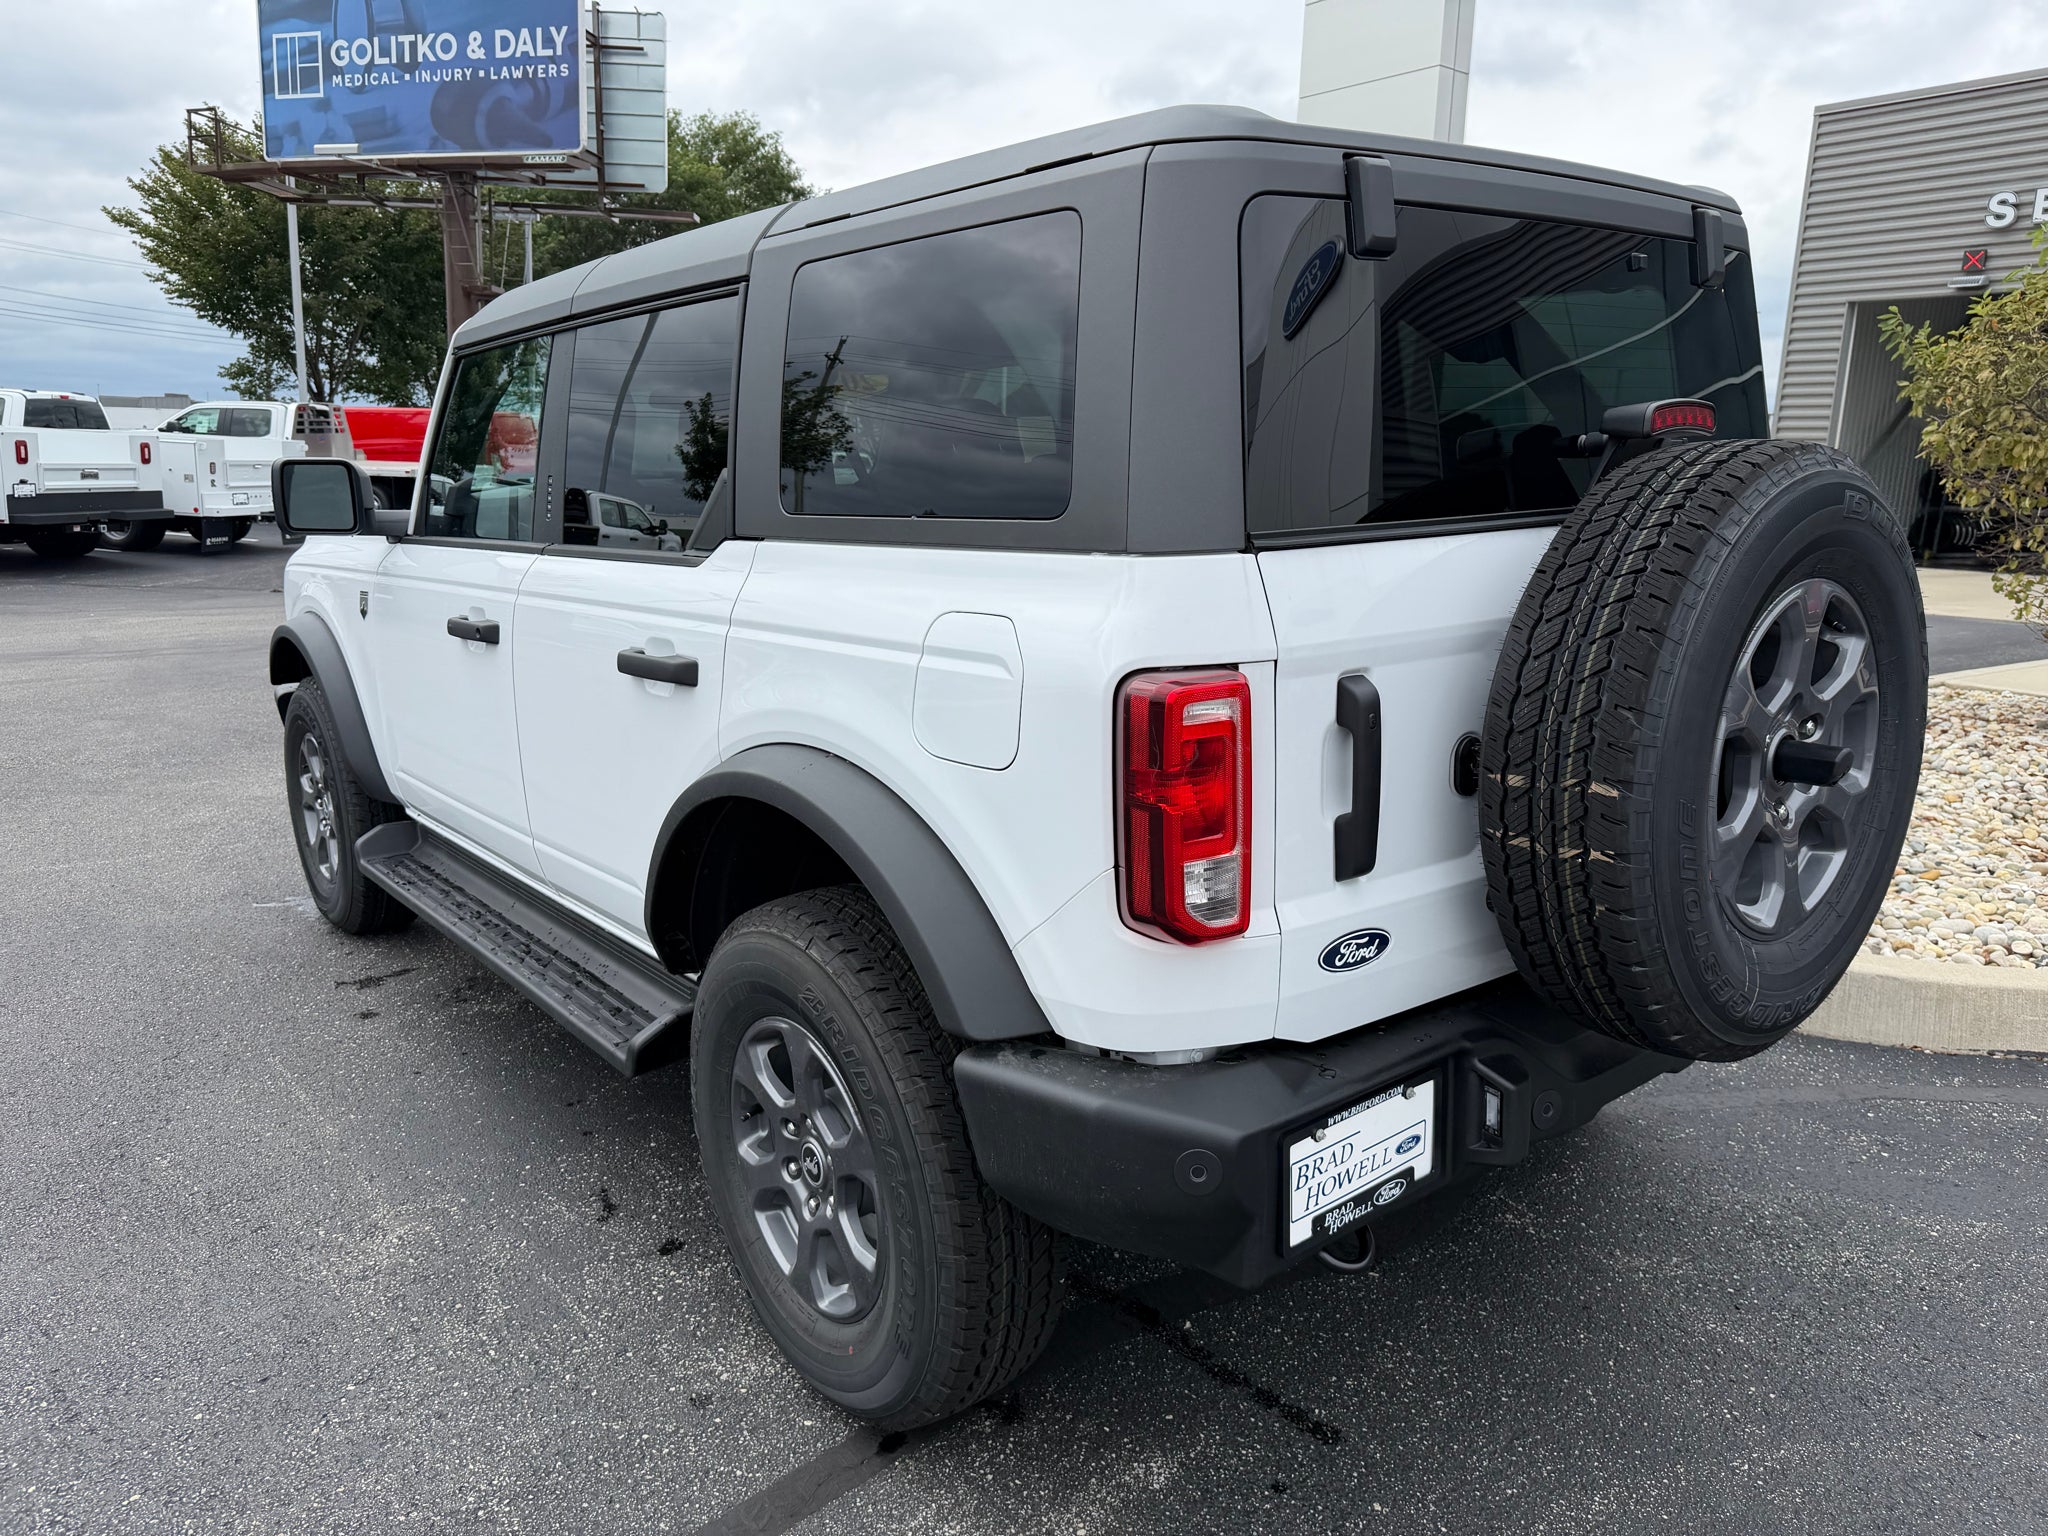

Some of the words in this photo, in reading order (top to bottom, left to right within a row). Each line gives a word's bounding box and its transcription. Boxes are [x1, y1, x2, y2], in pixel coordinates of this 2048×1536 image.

[330, 32, 458, 67] GOLITKO
[466, 30, 487, 60] &
[494, 25, 569, 59] DALY
[332, 71, 399, 87] MEDICAL
[415, 67, 473, 83] INJURY
[489, 63, 569, 80] LAWYERS
[1334, 936, 1380, 967] Ford
[1327, 1084, 1405, 1127] WWW.BHIFORD.COM
[799, 982, 918, 1360] BRIDGESTONE
[1294, 1142, 1355, 1192] BRAD
[1303, 1146, 1393, 1213] HOWELL
[1324, 1201, 1355, 1227] BRAD
[1328, 1201, 1374, 1235] HOWELL
[1378, 1181, 1402, 1203] Ford
